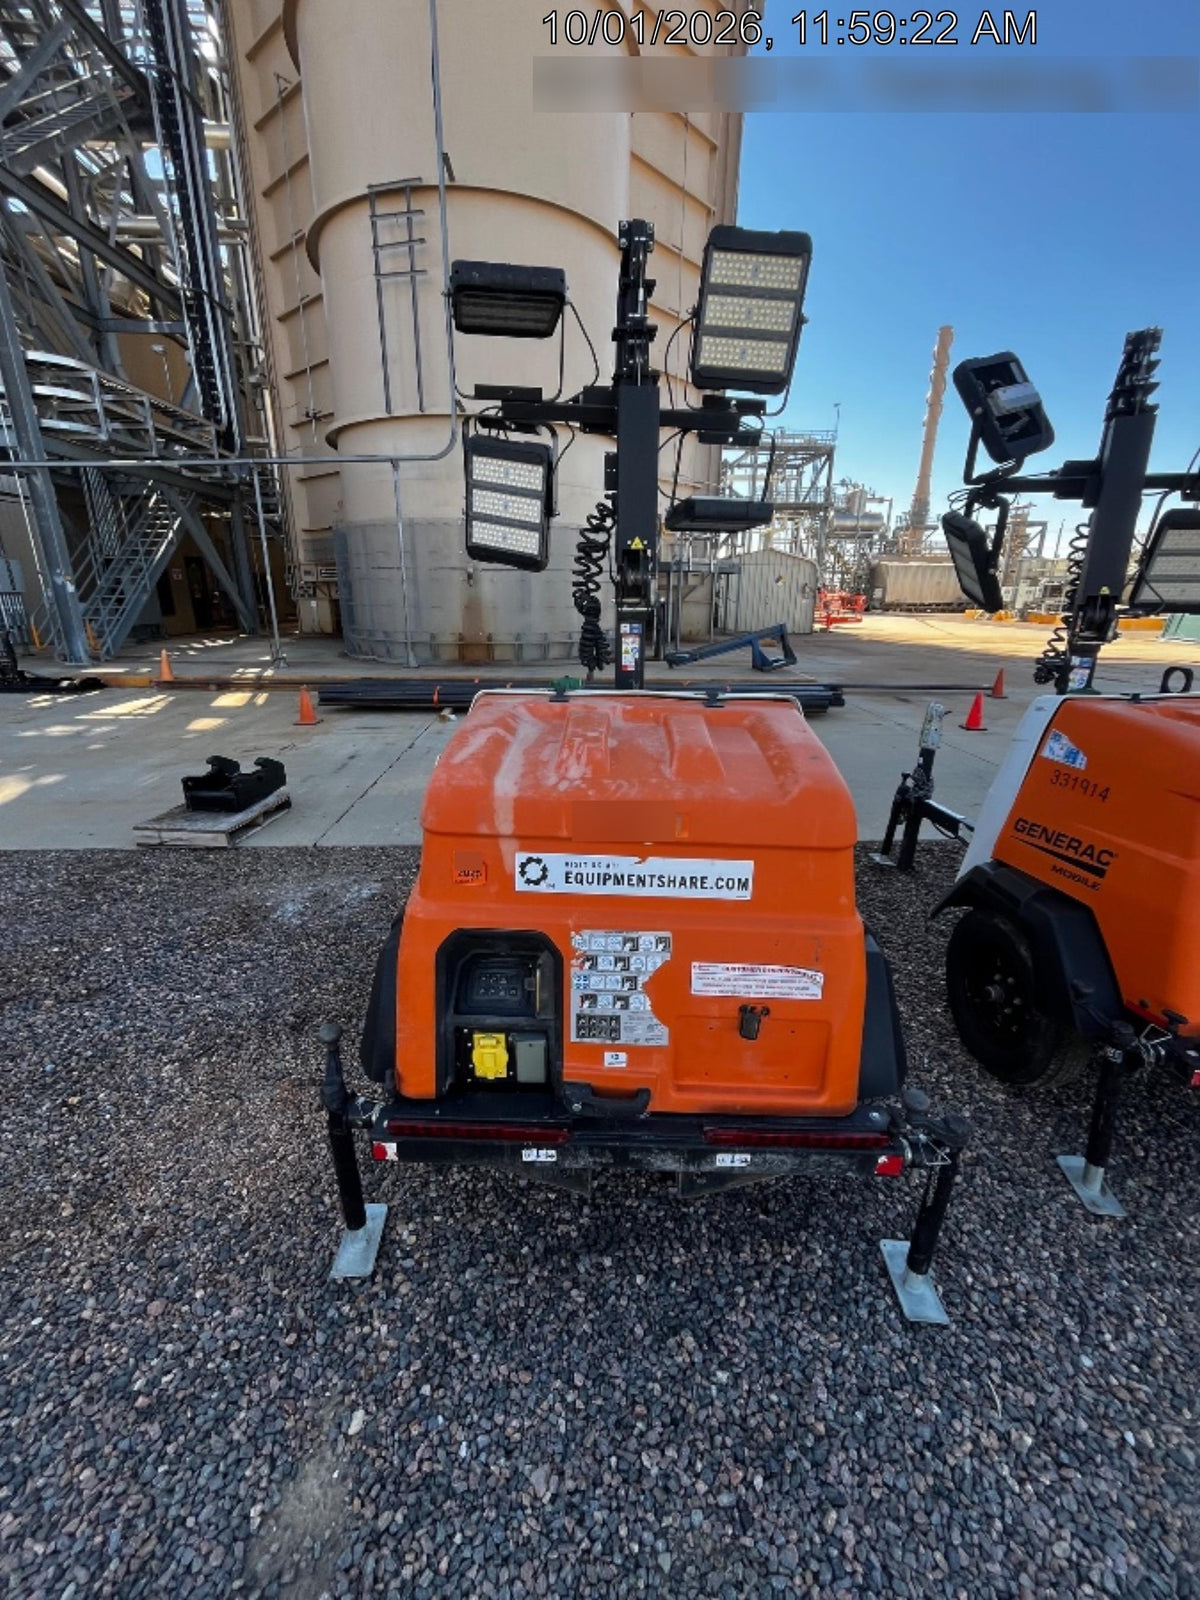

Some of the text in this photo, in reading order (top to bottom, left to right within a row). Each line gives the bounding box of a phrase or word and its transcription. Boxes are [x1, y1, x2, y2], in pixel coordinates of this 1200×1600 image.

[1050, 769, 1110, 803] 331914
[1013, 817, 1115, 867] GENERAC
[564, 871, 750, 892] EQUIPMENTSHARE.COM
[1050, 865, 1101, 891] MOBILE
